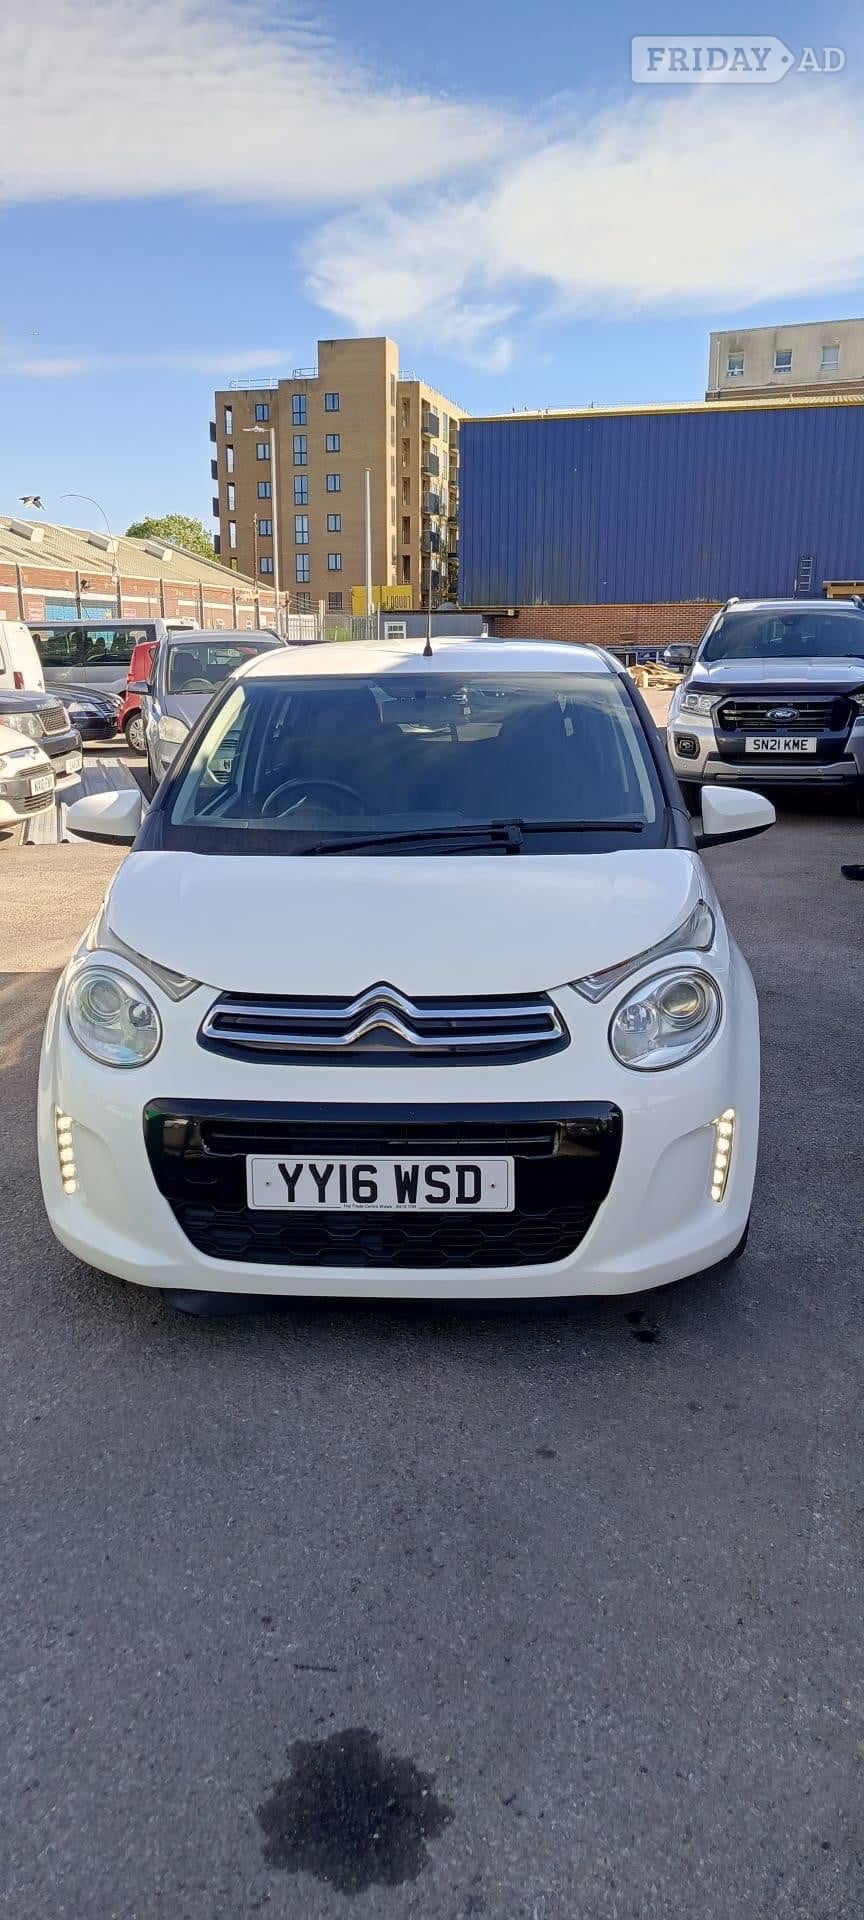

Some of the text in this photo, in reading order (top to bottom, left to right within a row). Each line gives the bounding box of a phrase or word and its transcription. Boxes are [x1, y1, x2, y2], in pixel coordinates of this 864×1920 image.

[753, 739, 808, 751] SN21 KME
[278, 1163, 482, 1205] YY16 WSD
